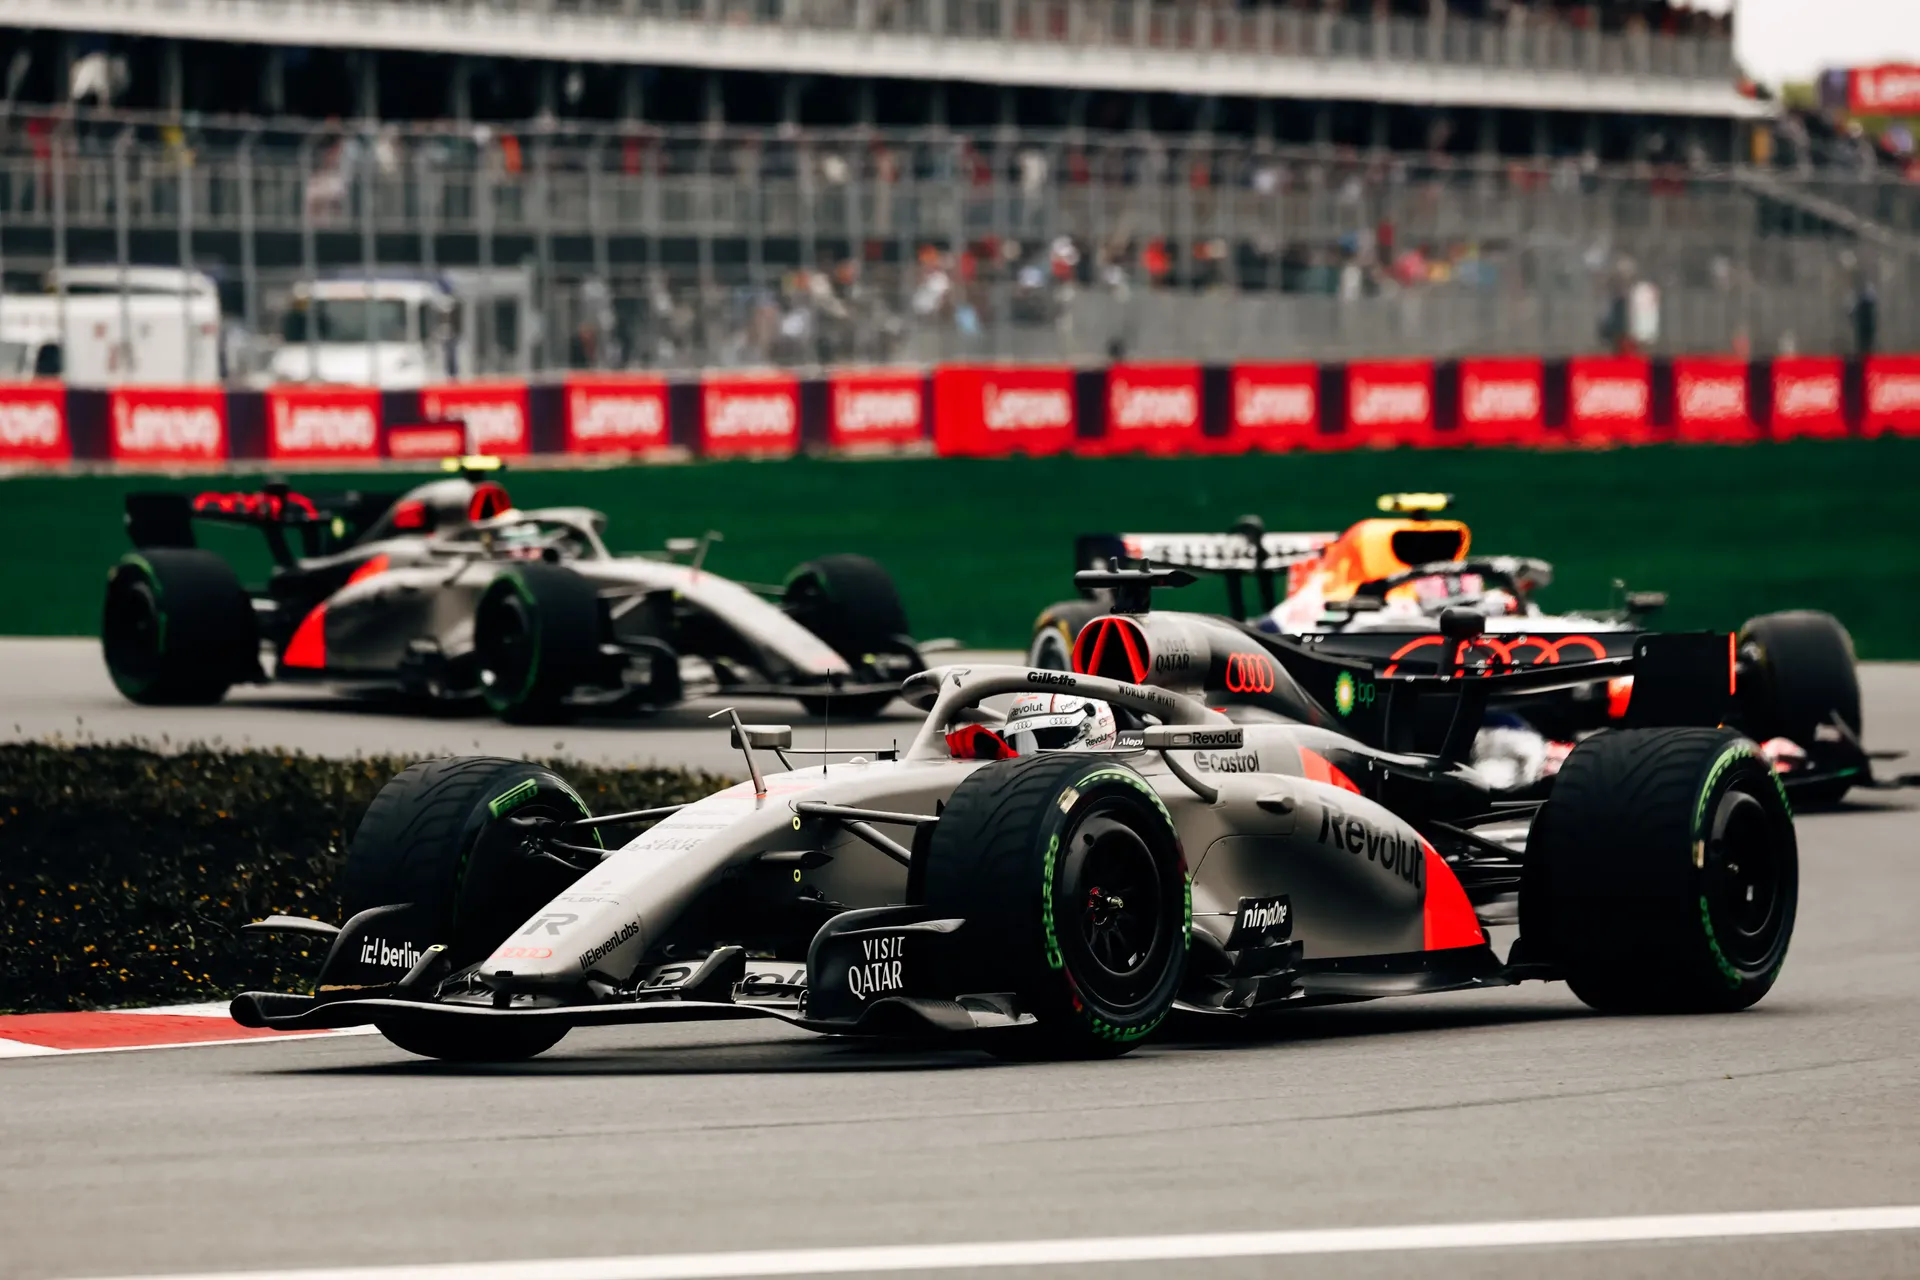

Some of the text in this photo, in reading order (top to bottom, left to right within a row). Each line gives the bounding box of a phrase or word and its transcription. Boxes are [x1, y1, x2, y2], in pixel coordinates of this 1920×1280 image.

[1155, 653, 1190, 675] QATAR
[1027, 671, 1077, 687] Gillette
[1358, 677, 1376, 710] bp
[1192, 731, 1242, 745] Revolut
[1210, 750, 1260, 774] Castrol
[1317, 796, 1424, 890] Revolut
[1242, 900, 1288, 934] ninjaOne
[360, 935, 380, 965] ic!
[862, 936, 906, 961] VISIT
[848, 960, 904, 1001] QATAR
